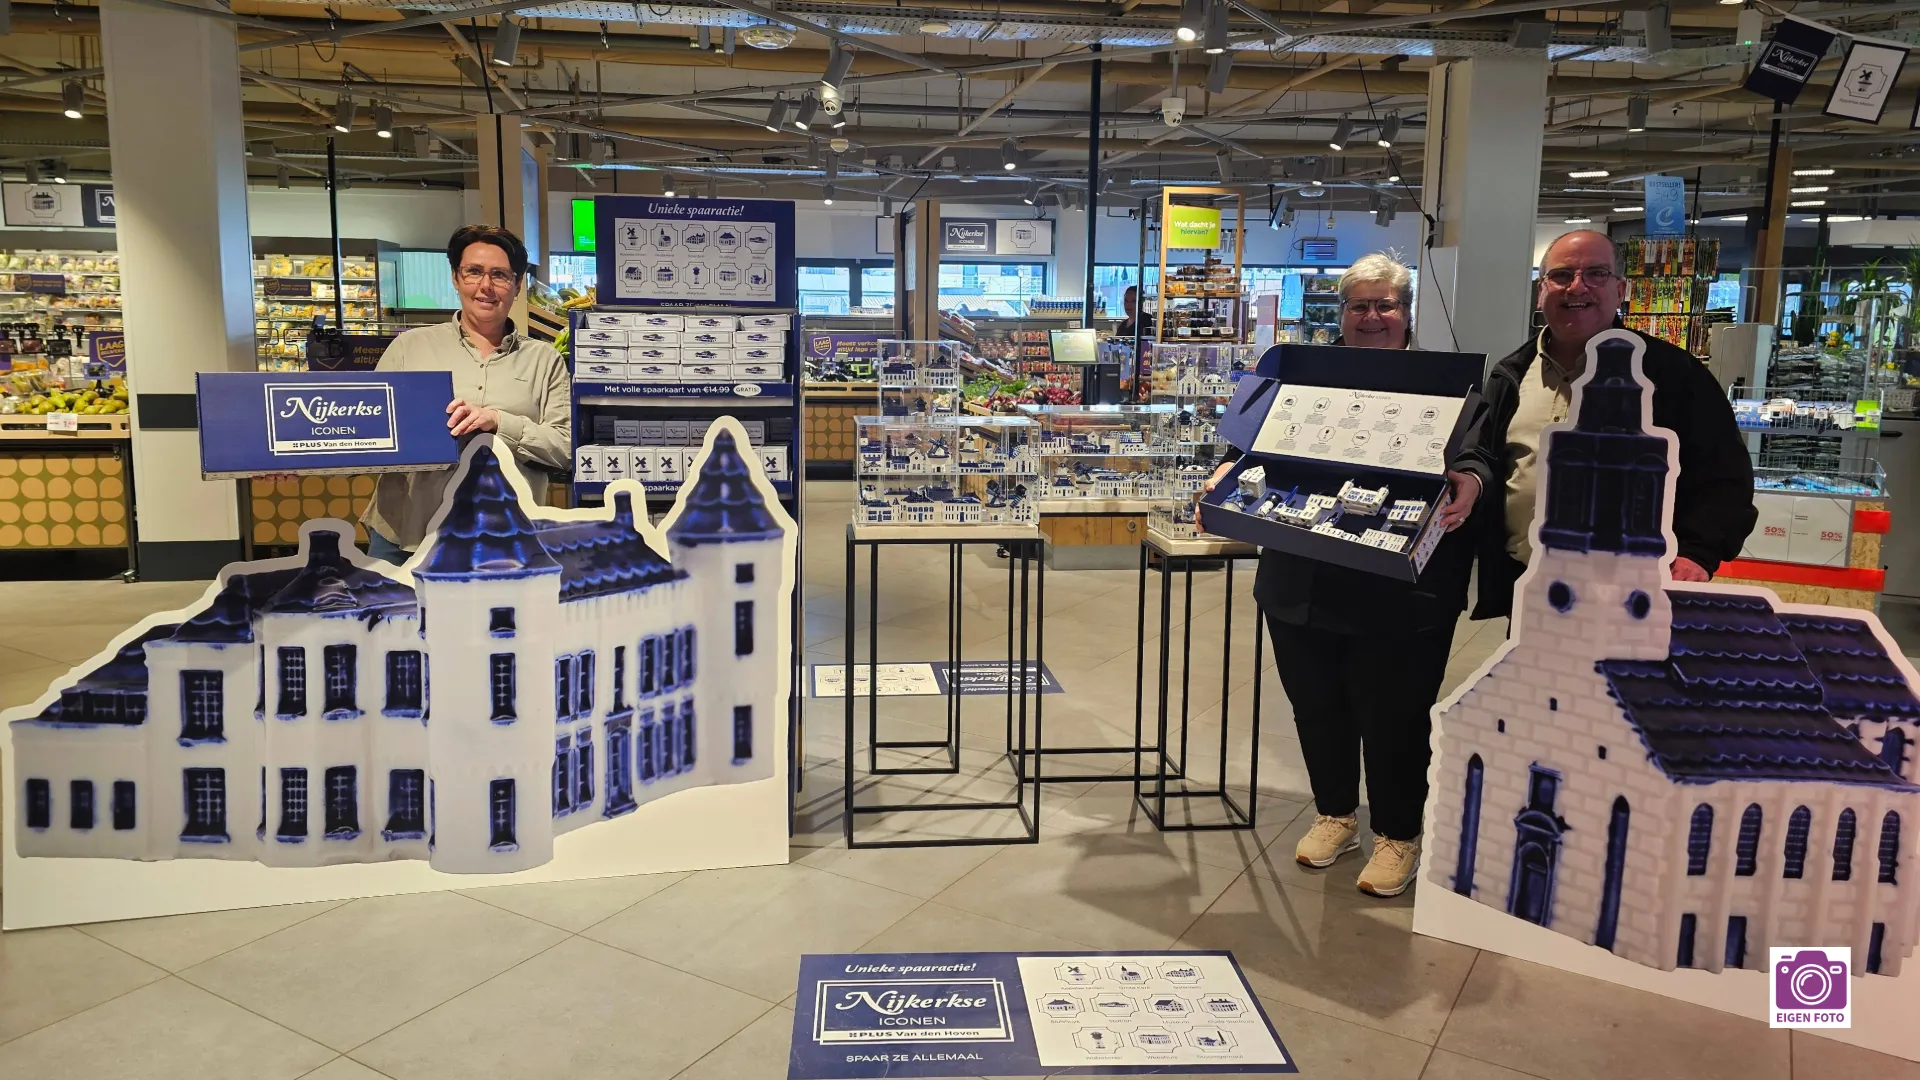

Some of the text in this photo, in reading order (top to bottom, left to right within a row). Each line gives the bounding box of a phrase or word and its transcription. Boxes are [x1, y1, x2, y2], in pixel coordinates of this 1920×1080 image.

[1772, 49, 1809, 67] Nijkerkse
[648, 203, 745, 218] Unieke spaaractie!
[1190, 220, 1208, 228] dacht
[1209, 222, 1216, 230] je
[950, 228, 984, 239] Nijkerkse
[100, 340, 124, 350] LAAG
[642, 386, 684, 394] spaarkaart
[280, 396, 382, 424] Nijkerkse
[312, 426, 356, 435] ICONEN
[1821, 531, 1842, 539] 50%
[844, 963, 976, 974] Unieke spaaractie!
[835, 990, 987, 1015] Nijkerkse
[879, 1016, 946, 1026] ICONEN
[846, 1054, 889, 1062] SPAAR
[912, 1053, 984, 1061] ALLEMAAL
